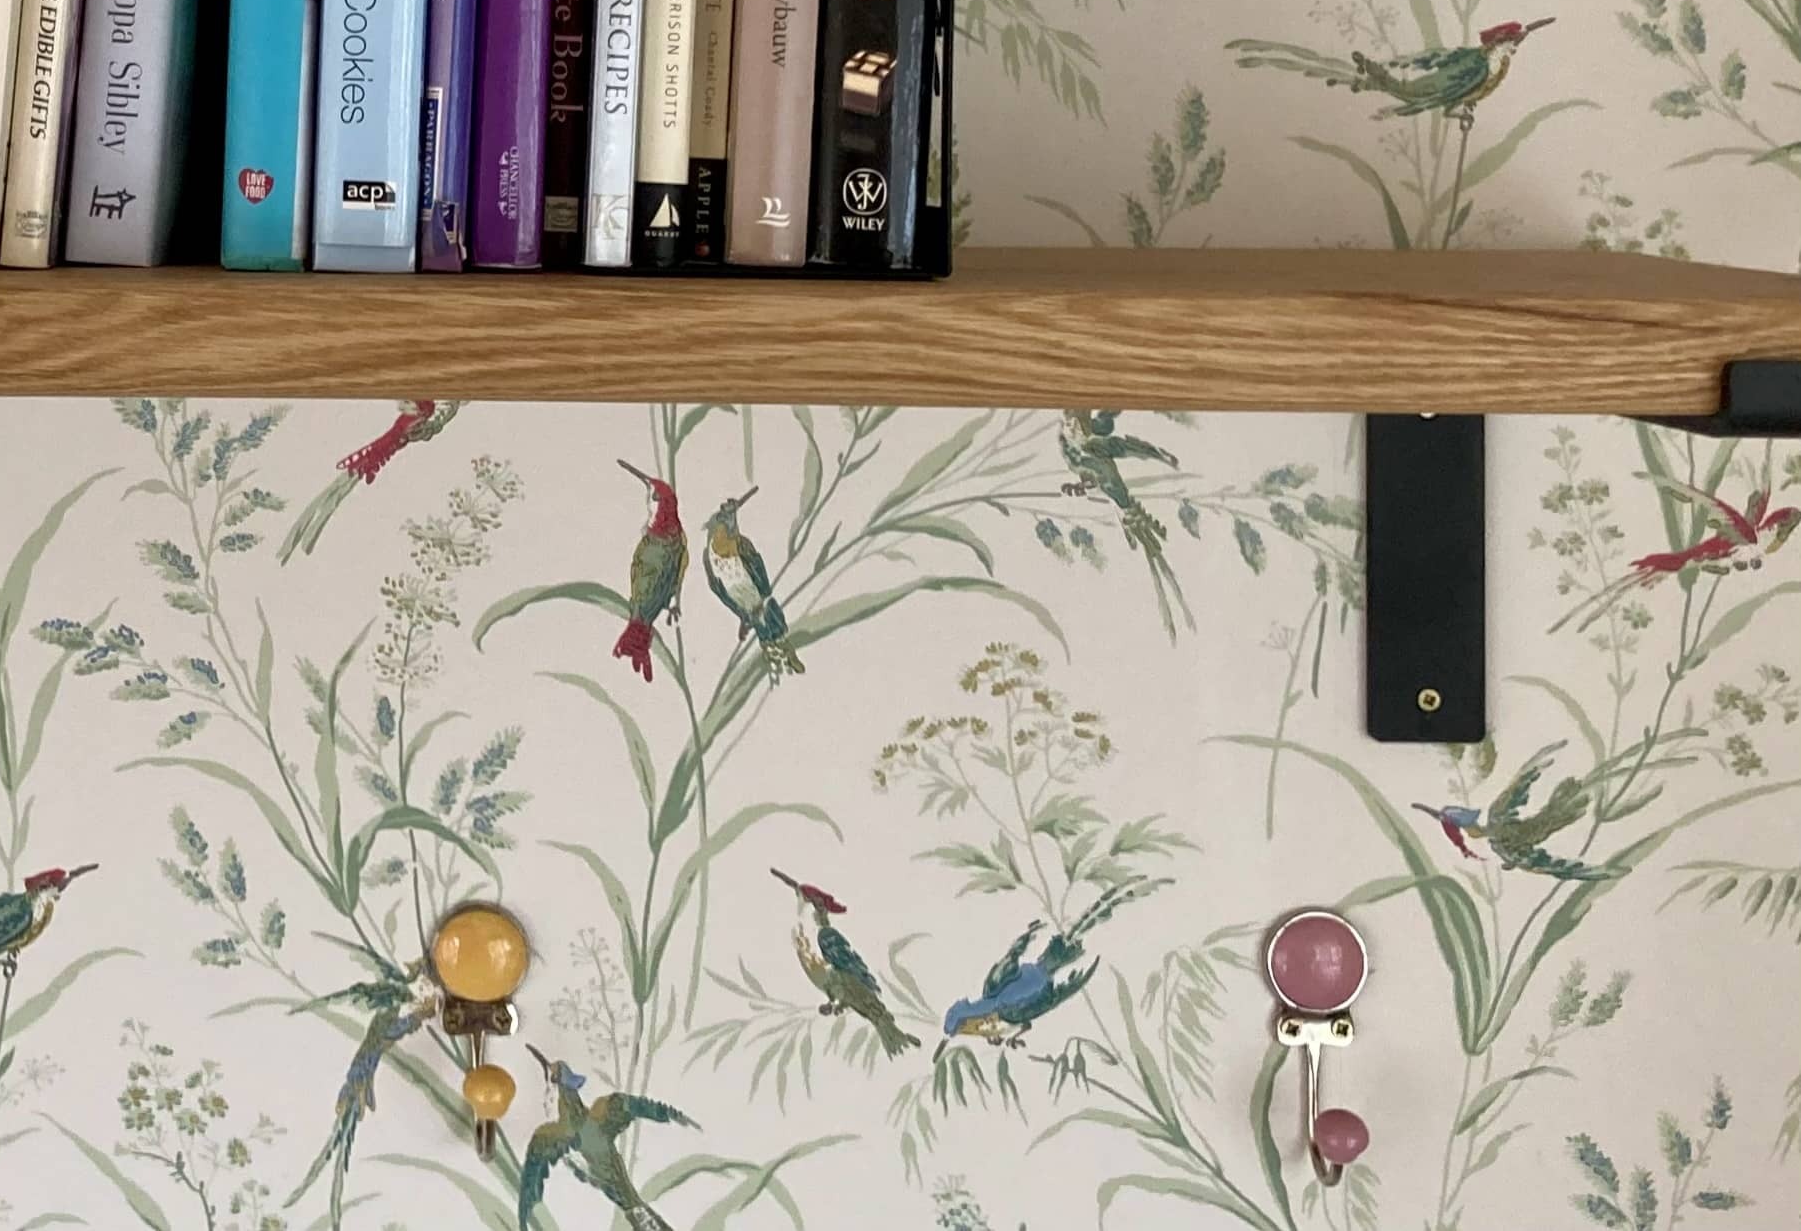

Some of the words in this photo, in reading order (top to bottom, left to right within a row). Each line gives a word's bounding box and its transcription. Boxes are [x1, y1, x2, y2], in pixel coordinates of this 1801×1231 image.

[35, 3, 58, 77] EDIBLE
[29, 79, 52, 140] GIFTS
[97, 60, 143, 155] Sibley
[549, 33, 584, 124] Book
[662, 63, 680, 130] SHOTTS
[245, 173, 267, 186] LOVE
[245, 185, 267, 199] FOOD
[347, 184, 384, 204] acp
[695, 167, 713, 235] APPLE
[842, 216, 886, 232] WILEY
